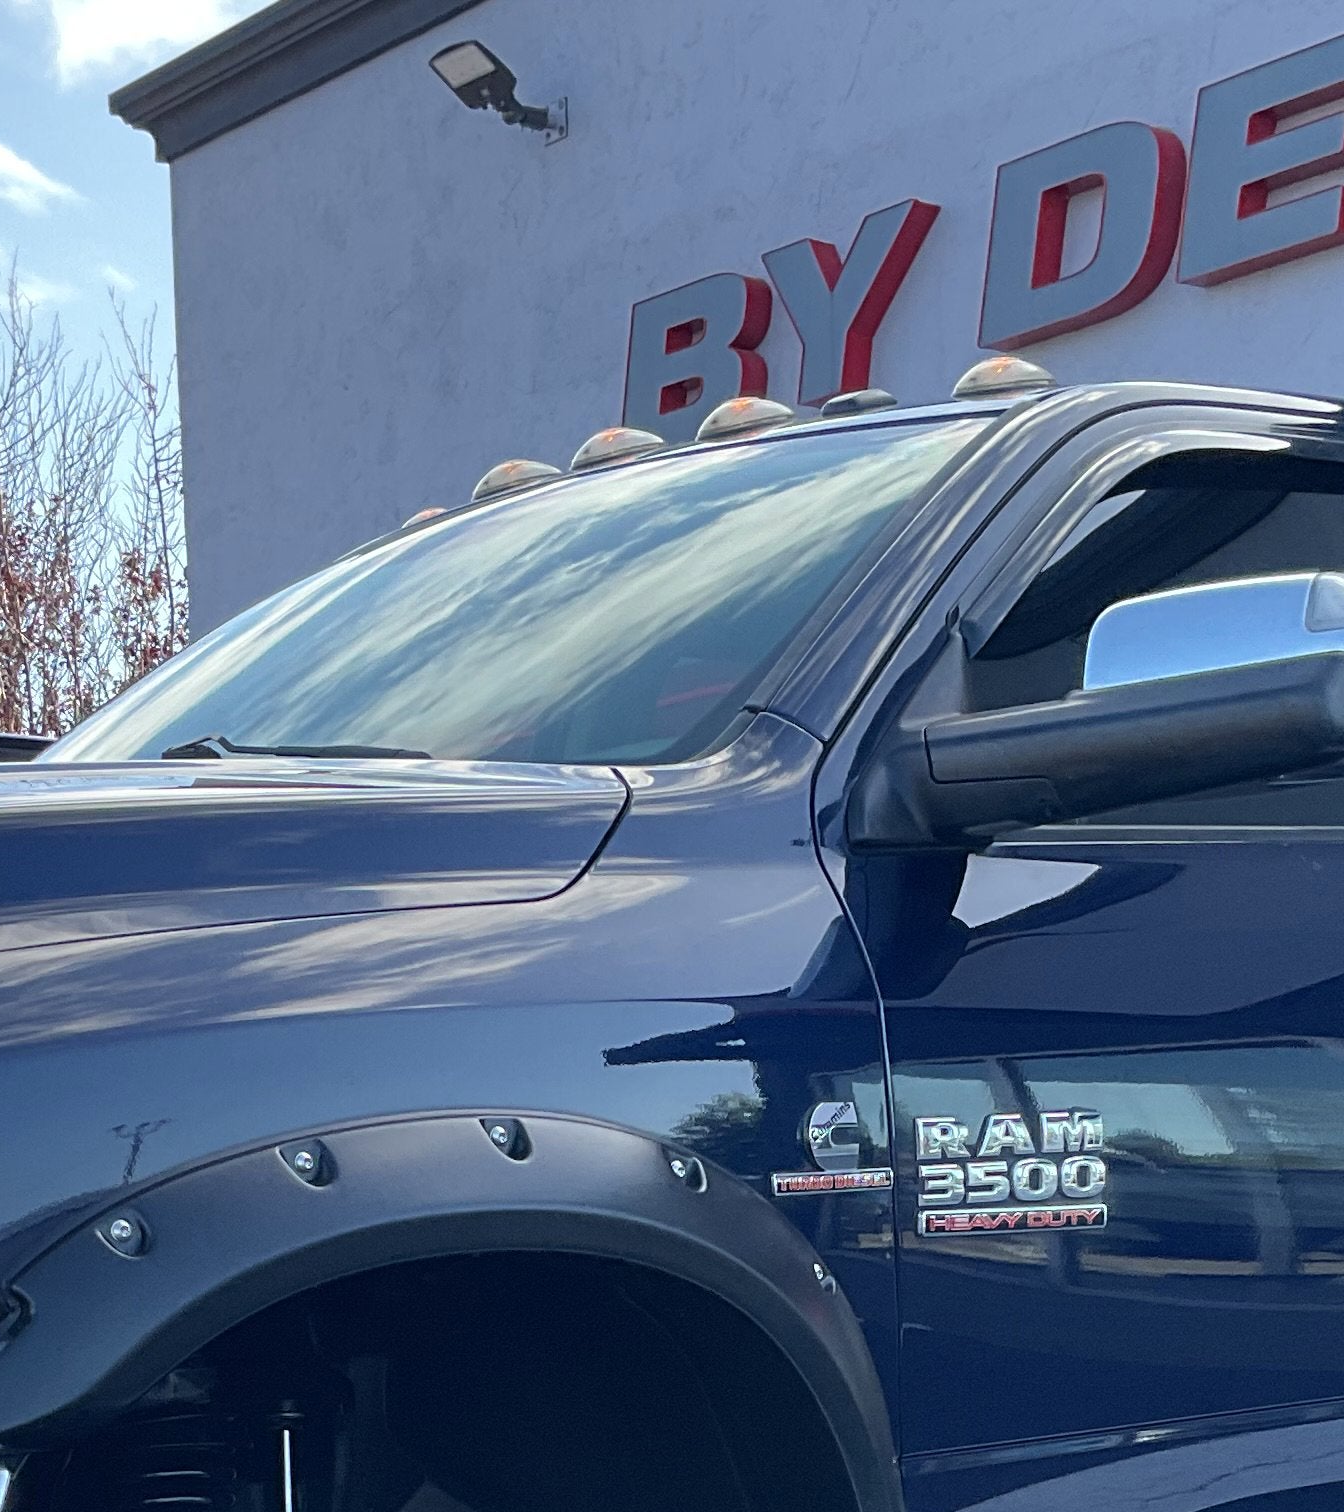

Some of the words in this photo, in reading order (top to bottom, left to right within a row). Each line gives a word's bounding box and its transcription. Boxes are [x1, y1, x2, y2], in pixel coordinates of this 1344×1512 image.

[622, 198, 941, 441] BY
[914, 1111, 1104, 1160] RAM
[918, 1155, 1107, 1206] 3500
[929, 1212, 1023, 1232] HEAVY
[1027, 1208, 1102, 1228] DUTY
